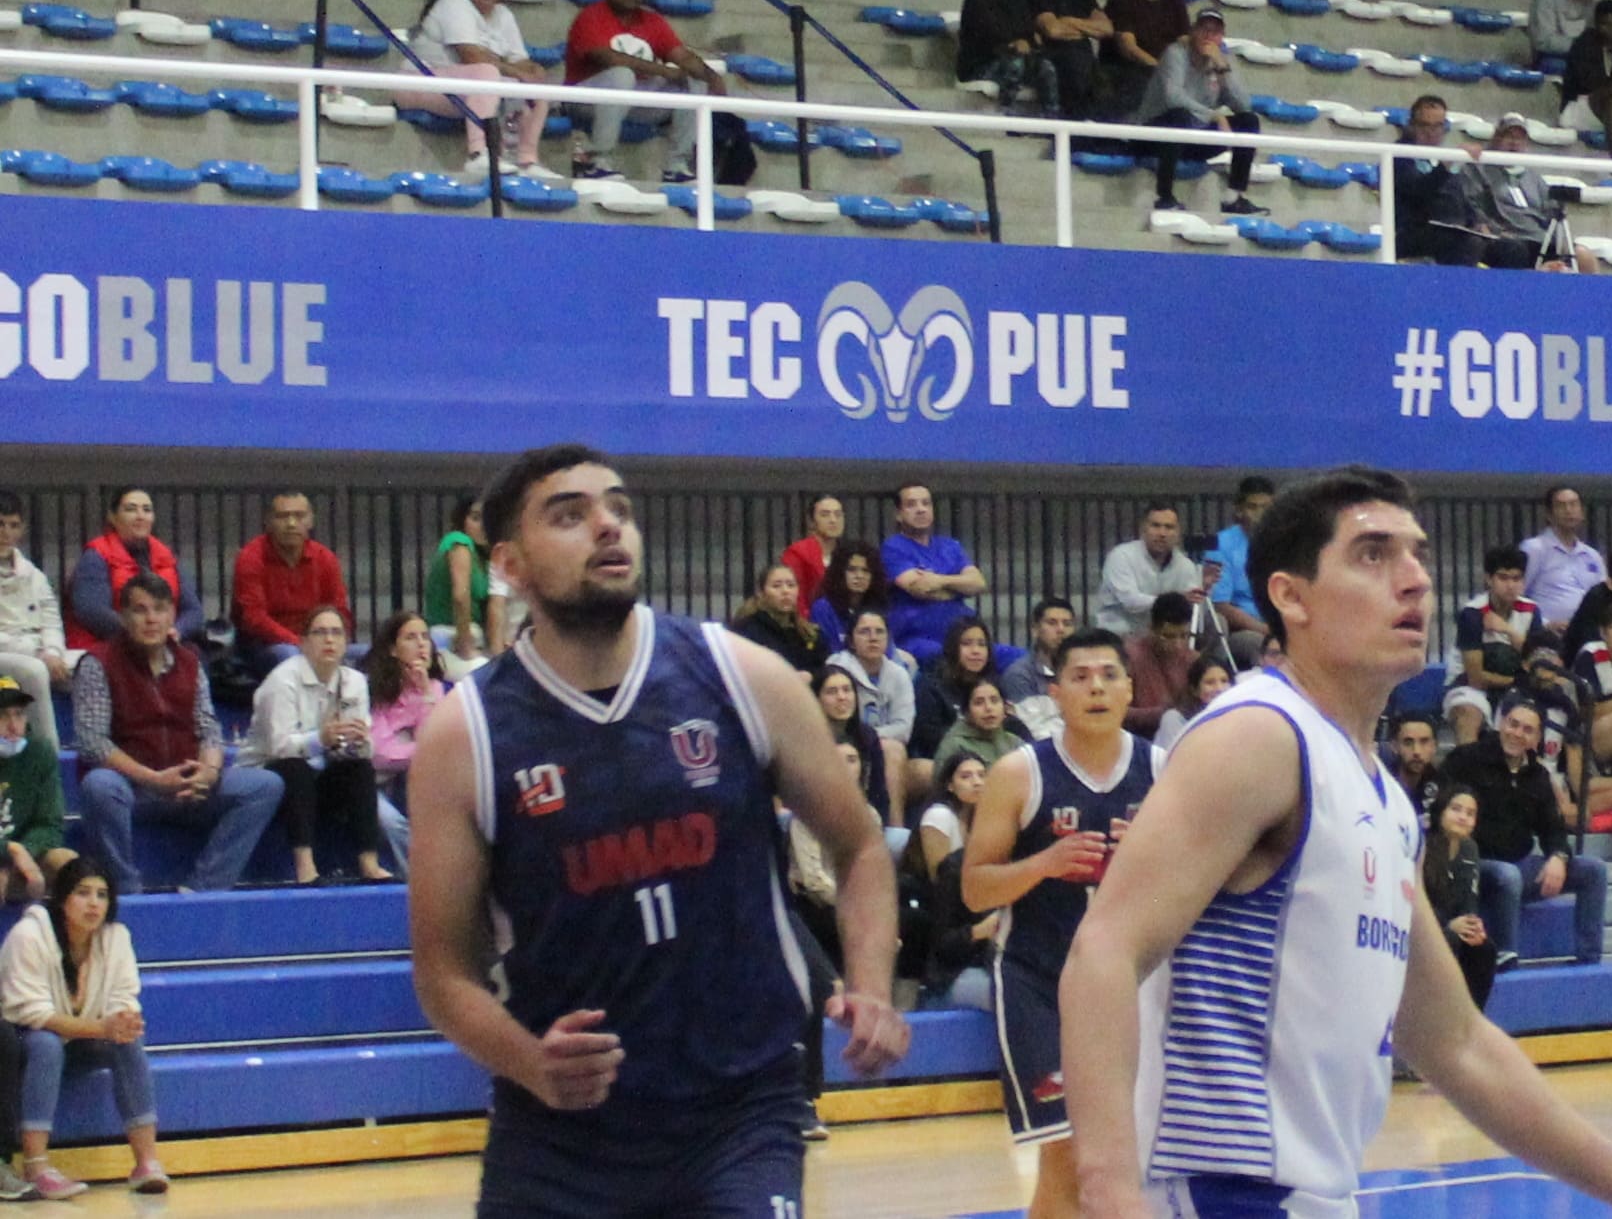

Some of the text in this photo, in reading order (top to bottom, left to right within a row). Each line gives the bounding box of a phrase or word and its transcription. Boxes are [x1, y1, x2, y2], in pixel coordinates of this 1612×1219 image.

[658, 297, 1129, 408] TEC PUE
[634, 883, 677, 945] 11
